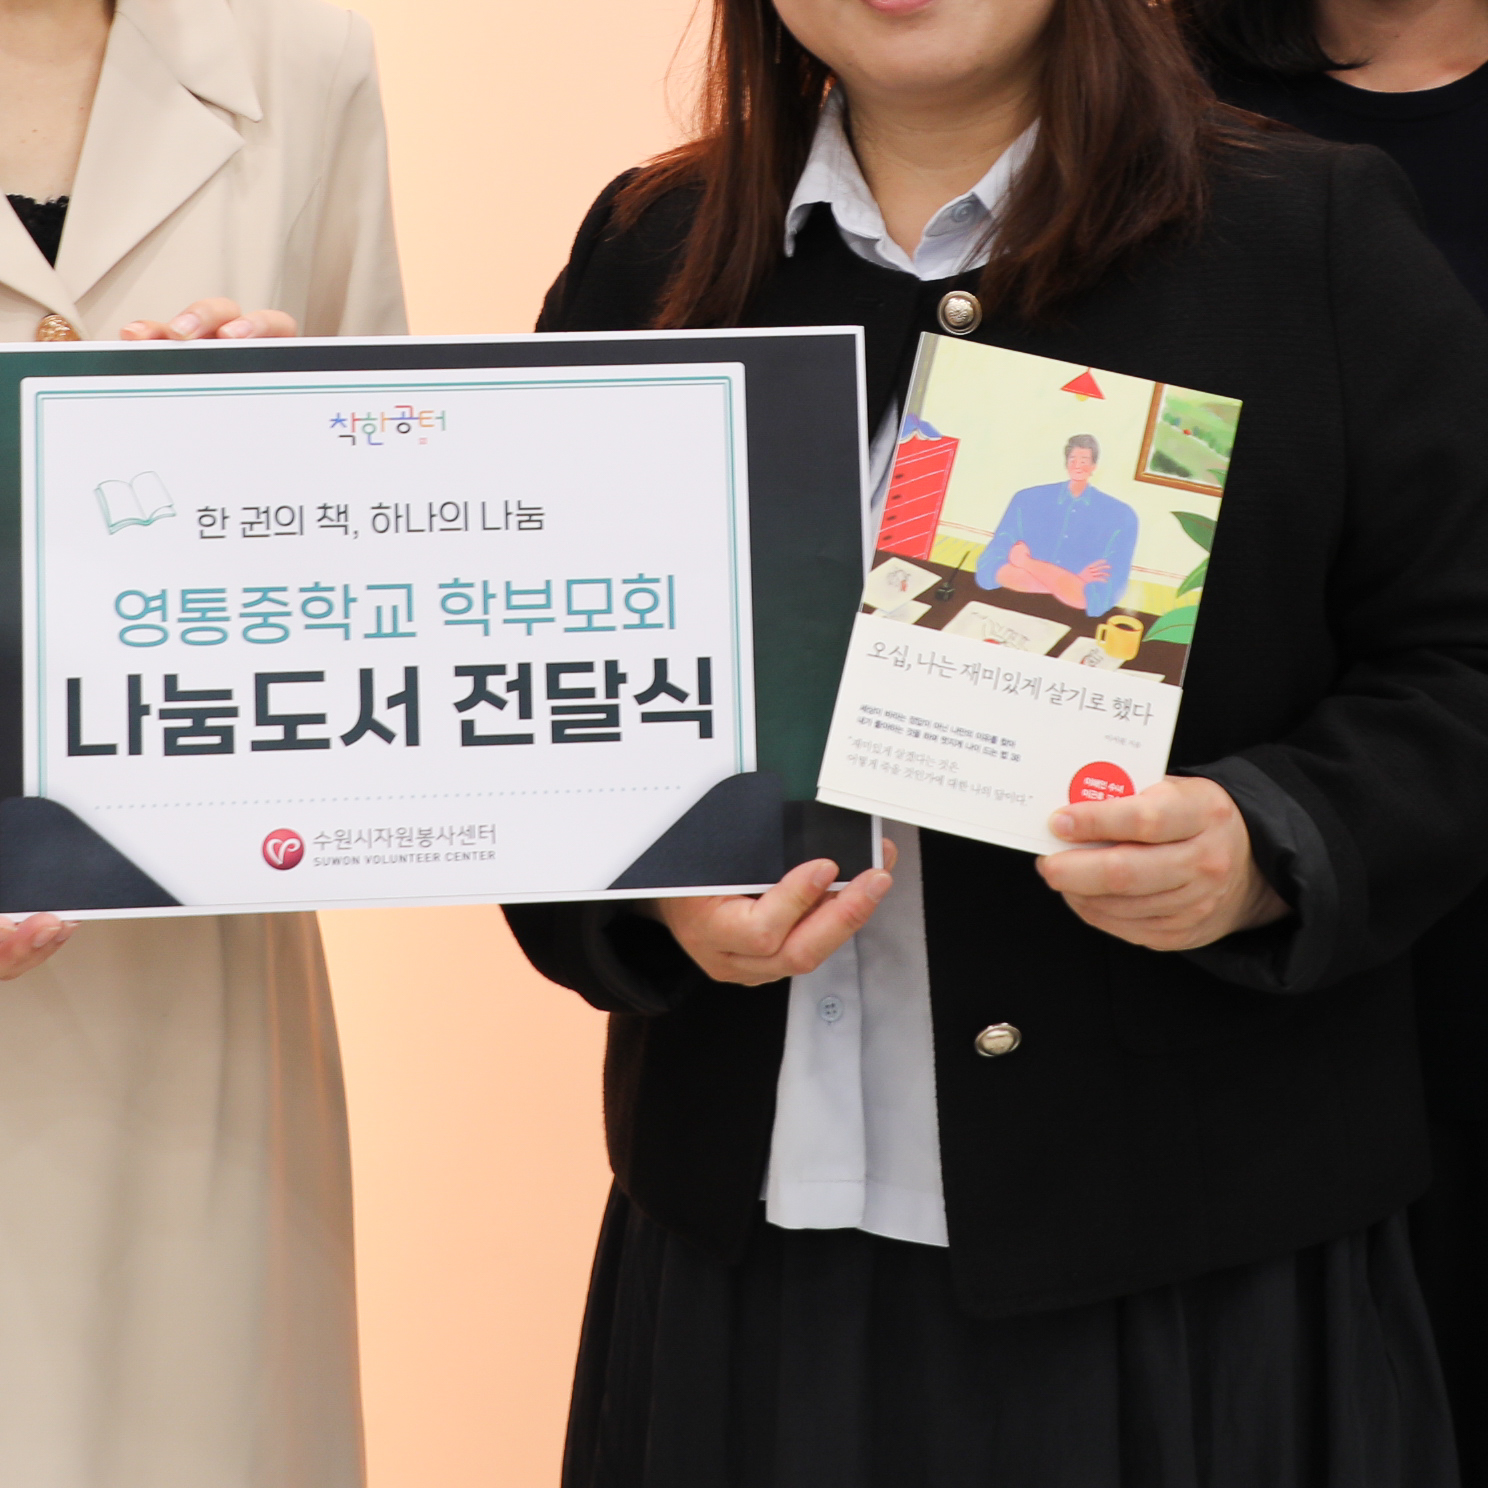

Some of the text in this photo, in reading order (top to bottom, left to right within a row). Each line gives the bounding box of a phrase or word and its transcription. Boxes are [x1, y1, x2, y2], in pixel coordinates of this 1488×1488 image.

[329, 404, 447, 447] 착한공터
[196, 498, 546, 540] 한 권의 책, 하나의 나눔
[114, 572, 677, 648] 영통중학교 학부모회
[867, 641, 1155, 726] 오십, 나는 재미있게 살기로 했다
[65, 656, 715, 758] 나눔도서 전달식
[313, 823, 497, 852] 수원시자원봉사센터
[313, 850, 497, 868] SUWON VOLUNTEER CENTER
